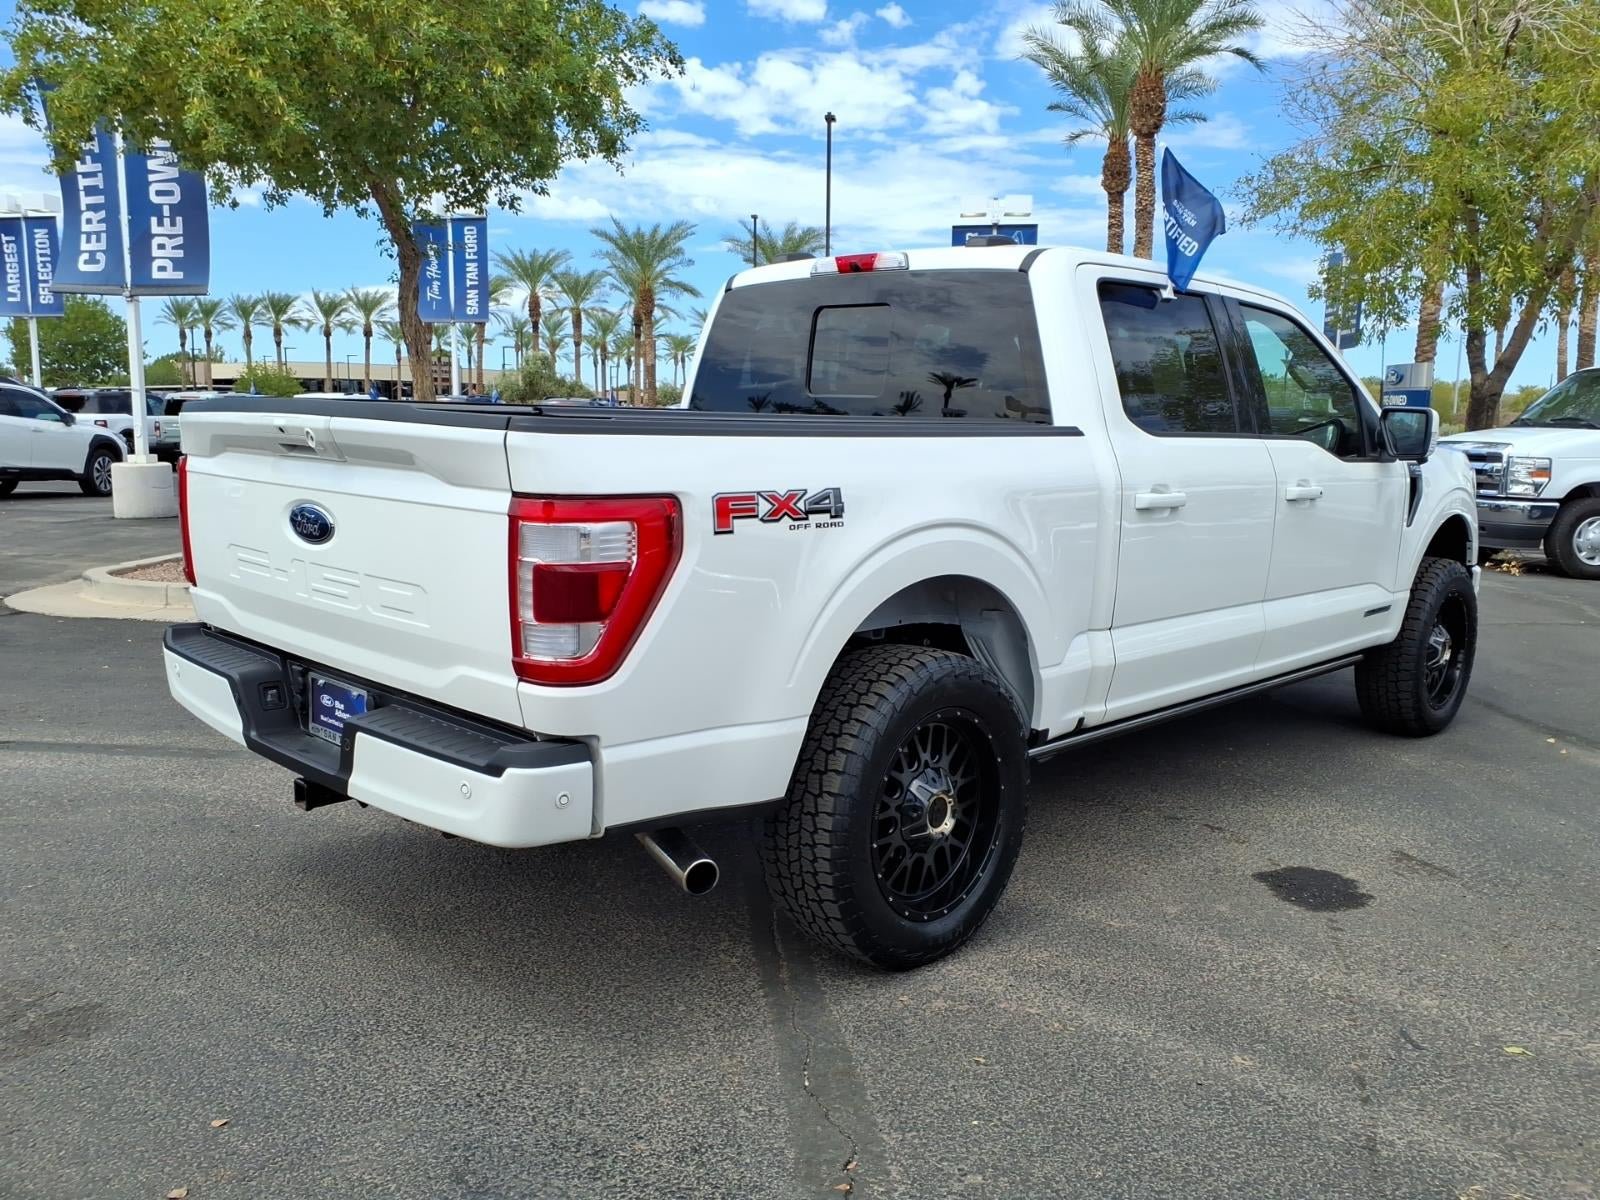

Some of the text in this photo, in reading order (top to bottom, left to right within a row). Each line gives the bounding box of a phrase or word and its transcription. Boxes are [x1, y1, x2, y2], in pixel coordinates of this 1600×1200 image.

[77, 123, 107, 272] CERTIFI
[1182, 212, 1198, 227] TAN
[1, 233, 21, 302] LARGEST
[426, 281, 442, 302] Tim
[464, 225, 479, 315] SAN TAN FORD
[291, 511, 322, 537] Ford
[711, 487, 845, 535] FX4
[789, 521, 844, 531] OFF ROAD
[227, 543, 431, 628] F-150
